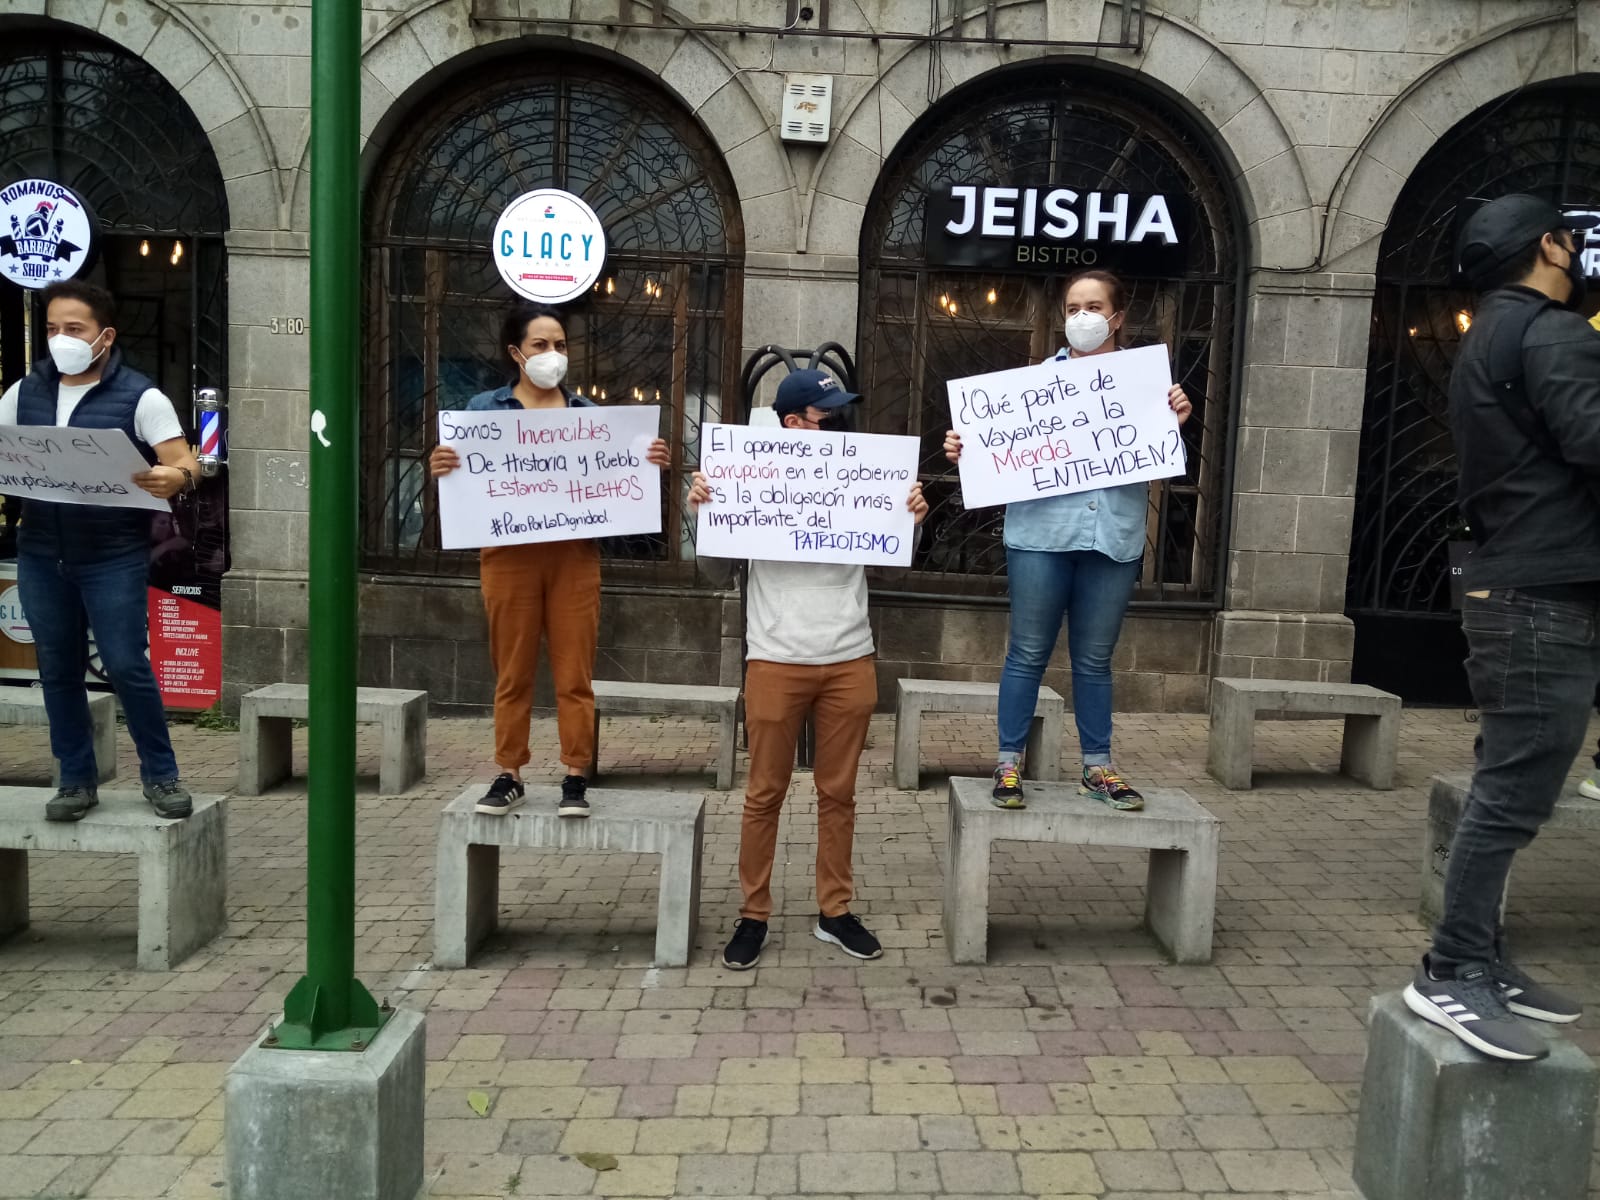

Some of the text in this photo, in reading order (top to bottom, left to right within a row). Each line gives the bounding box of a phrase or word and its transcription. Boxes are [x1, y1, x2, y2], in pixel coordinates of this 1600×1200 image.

[1, 181, 64, 205] ROMANOS
[945, 186, 1179, 244] JEISHA
[16, 240, 57, 257] BARBER
[501, 229, 593, 261] GLACY
[1017, 245, 1098, 265] BISTRO
[22, 263, 49, 278] SHOP
[271, 317, 303, 335] 3-80
[959, 385, 1014, 426] ¿Qué
[1089, 368, 1116, 393] de
[1072, 410, 1090, 428] a
[1101, 395, 1125, 421] la
[442, 412, 611, 445] Somos Invencibles
[711, 426, 857, 460] El oponerse a la
[466, 452, 497, 475] De
[501, 452, 567, 473] Historia
[992, 435, 1073, 475] Mierda
[704, 455, 909, 489] Corrupción en el gobierno
[487, 475, 644, 503] Estamos HECHOS
[736, 481, 752, 504] la
[759, 483, 845, 515] obligación
[853, 492, 893, 511] más
[807, 510, 832, 529] del
[789, 529, 900, 555] PATRIOTISMO
